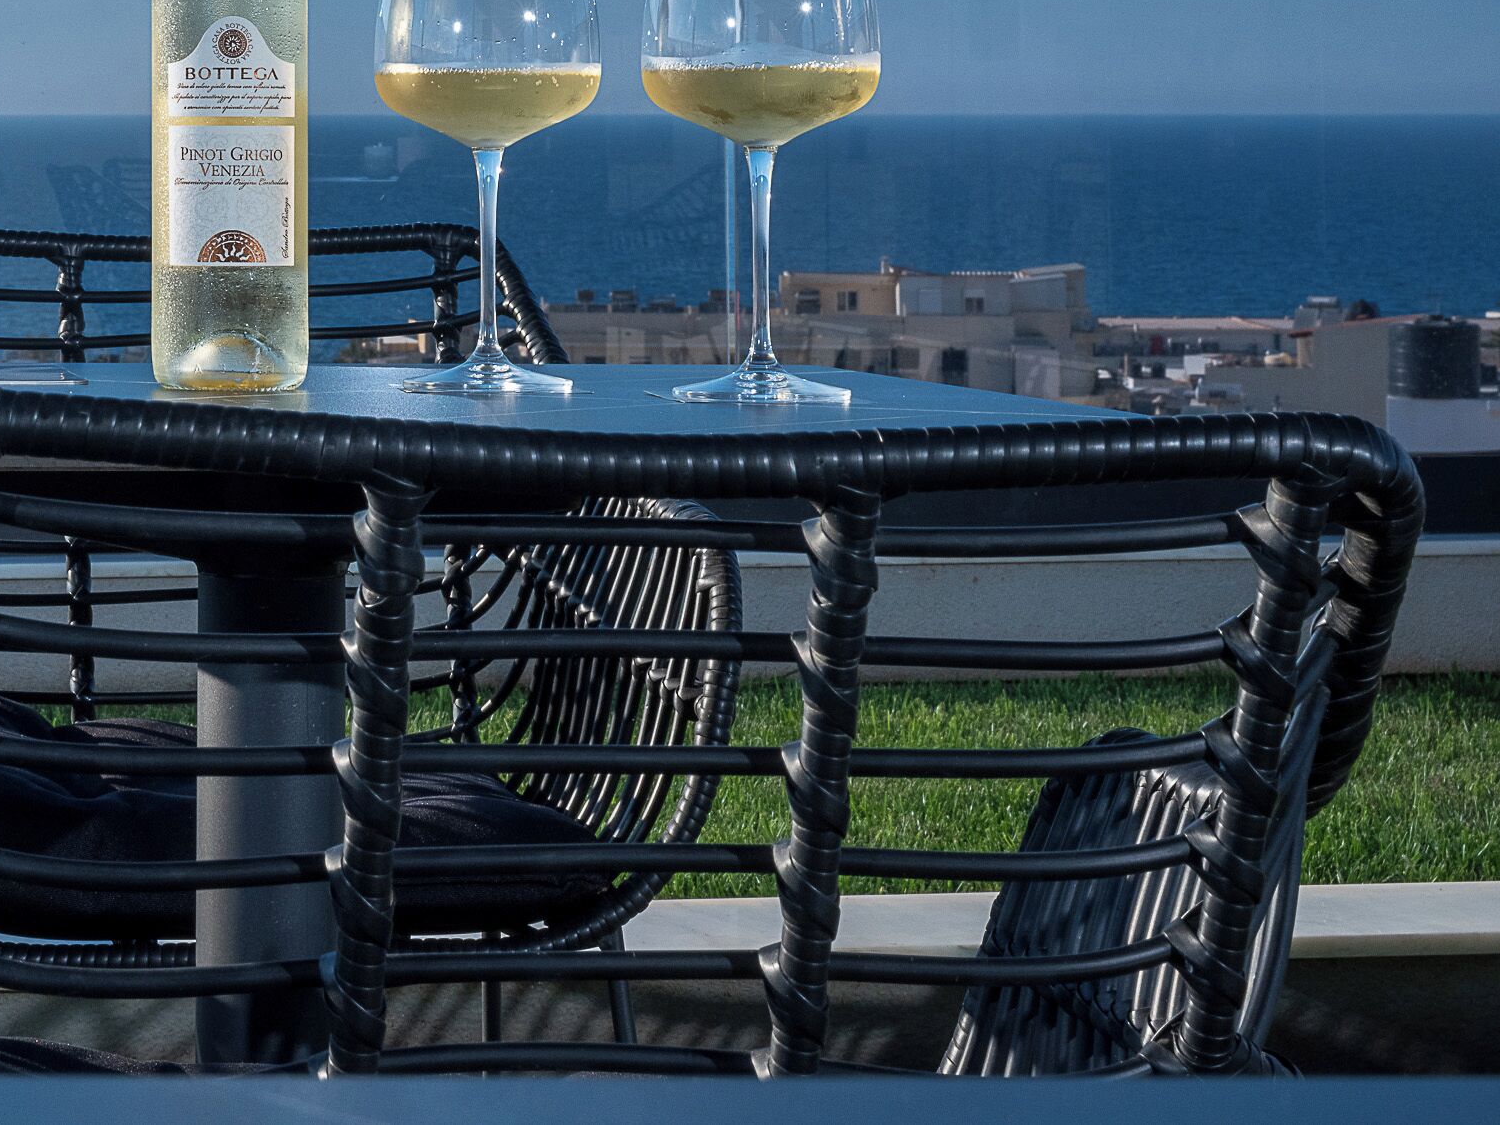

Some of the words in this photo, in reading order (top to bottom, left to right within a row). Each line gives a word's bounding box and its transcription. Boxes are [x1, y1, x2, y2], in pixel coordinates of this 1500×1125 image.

[185, 66, 279, 80] BOTTEGA
[180, 146, 226, 161] PINOT
[230, 146, 283, 161] GRIGIO
[199, 162, 265, 177] VENEZIA
[224, 177, 232, 185] di
